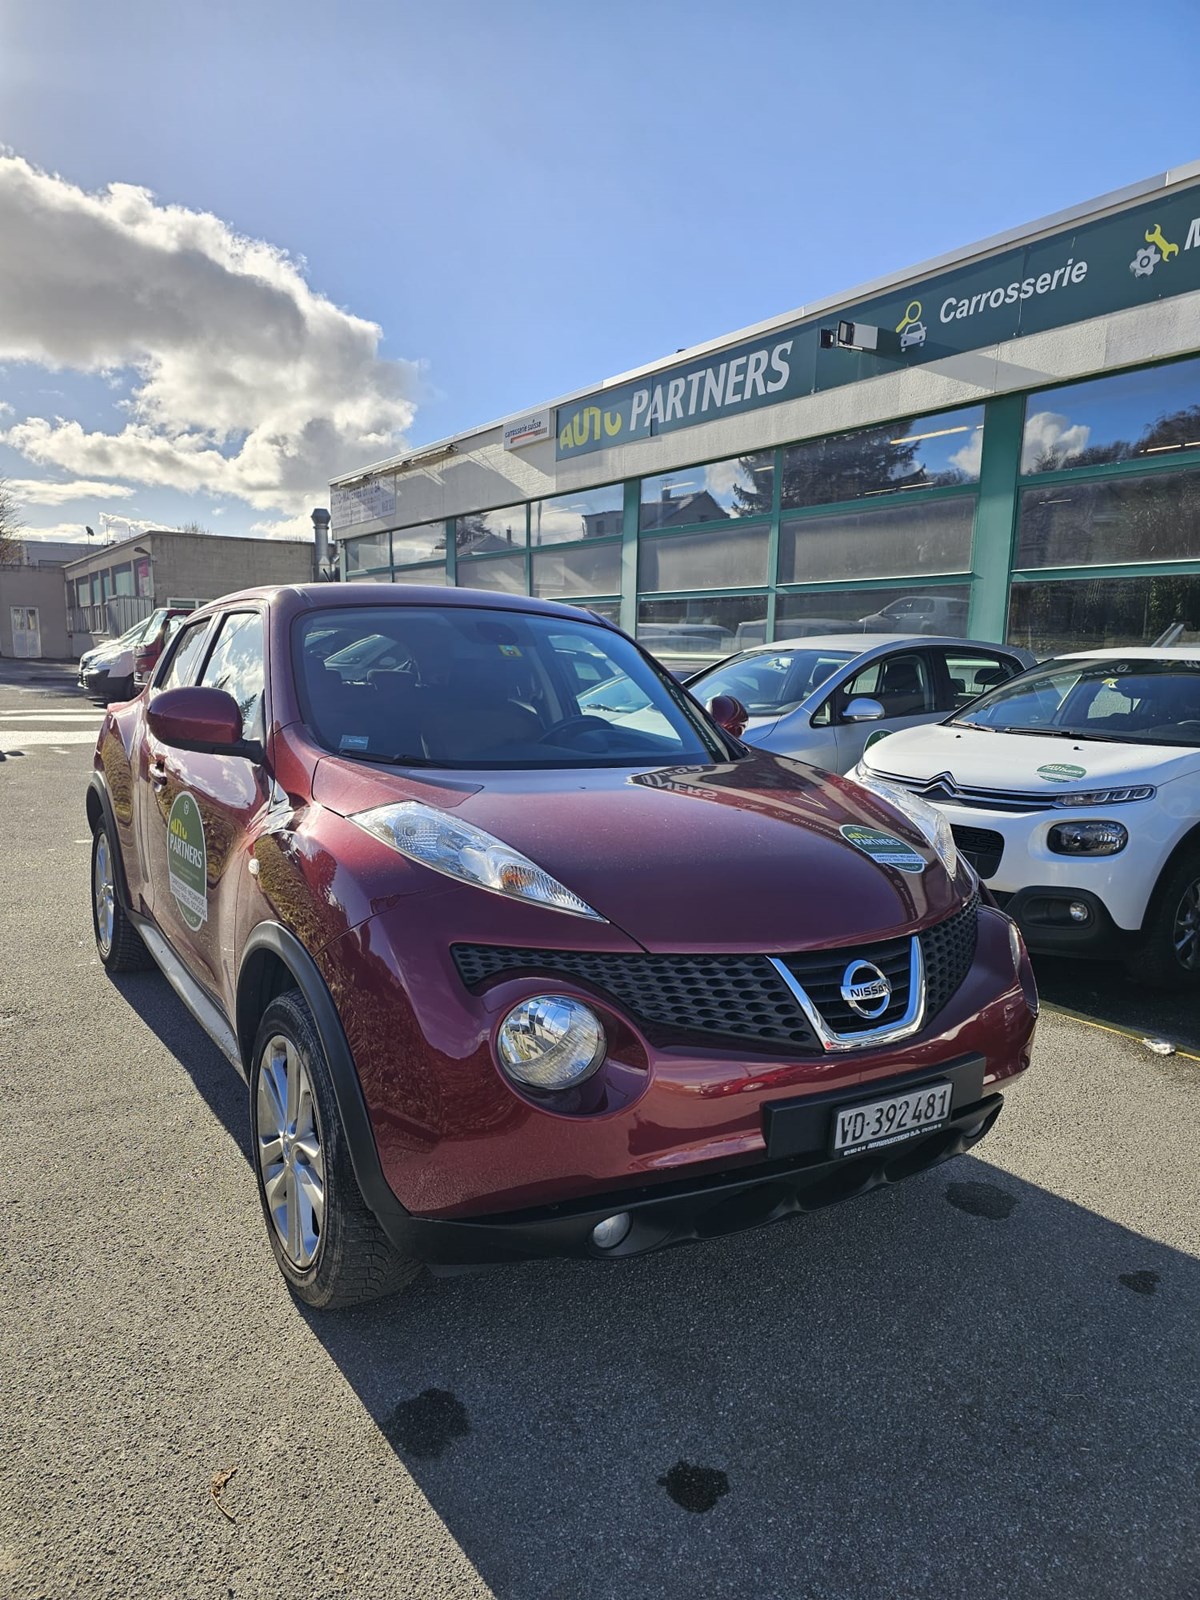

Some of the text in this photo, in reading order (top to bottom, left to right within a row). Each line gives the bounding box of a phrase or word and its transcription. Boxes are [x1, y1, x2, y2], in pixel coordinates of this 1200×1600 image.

[939, 257, 1088, 324] Carrosserie
[559, 340, 794, 451] AUTO PARTNERS
[169, 832, 203, 869] PARTNERS
[850, 983, 891, 998] NISSAN
